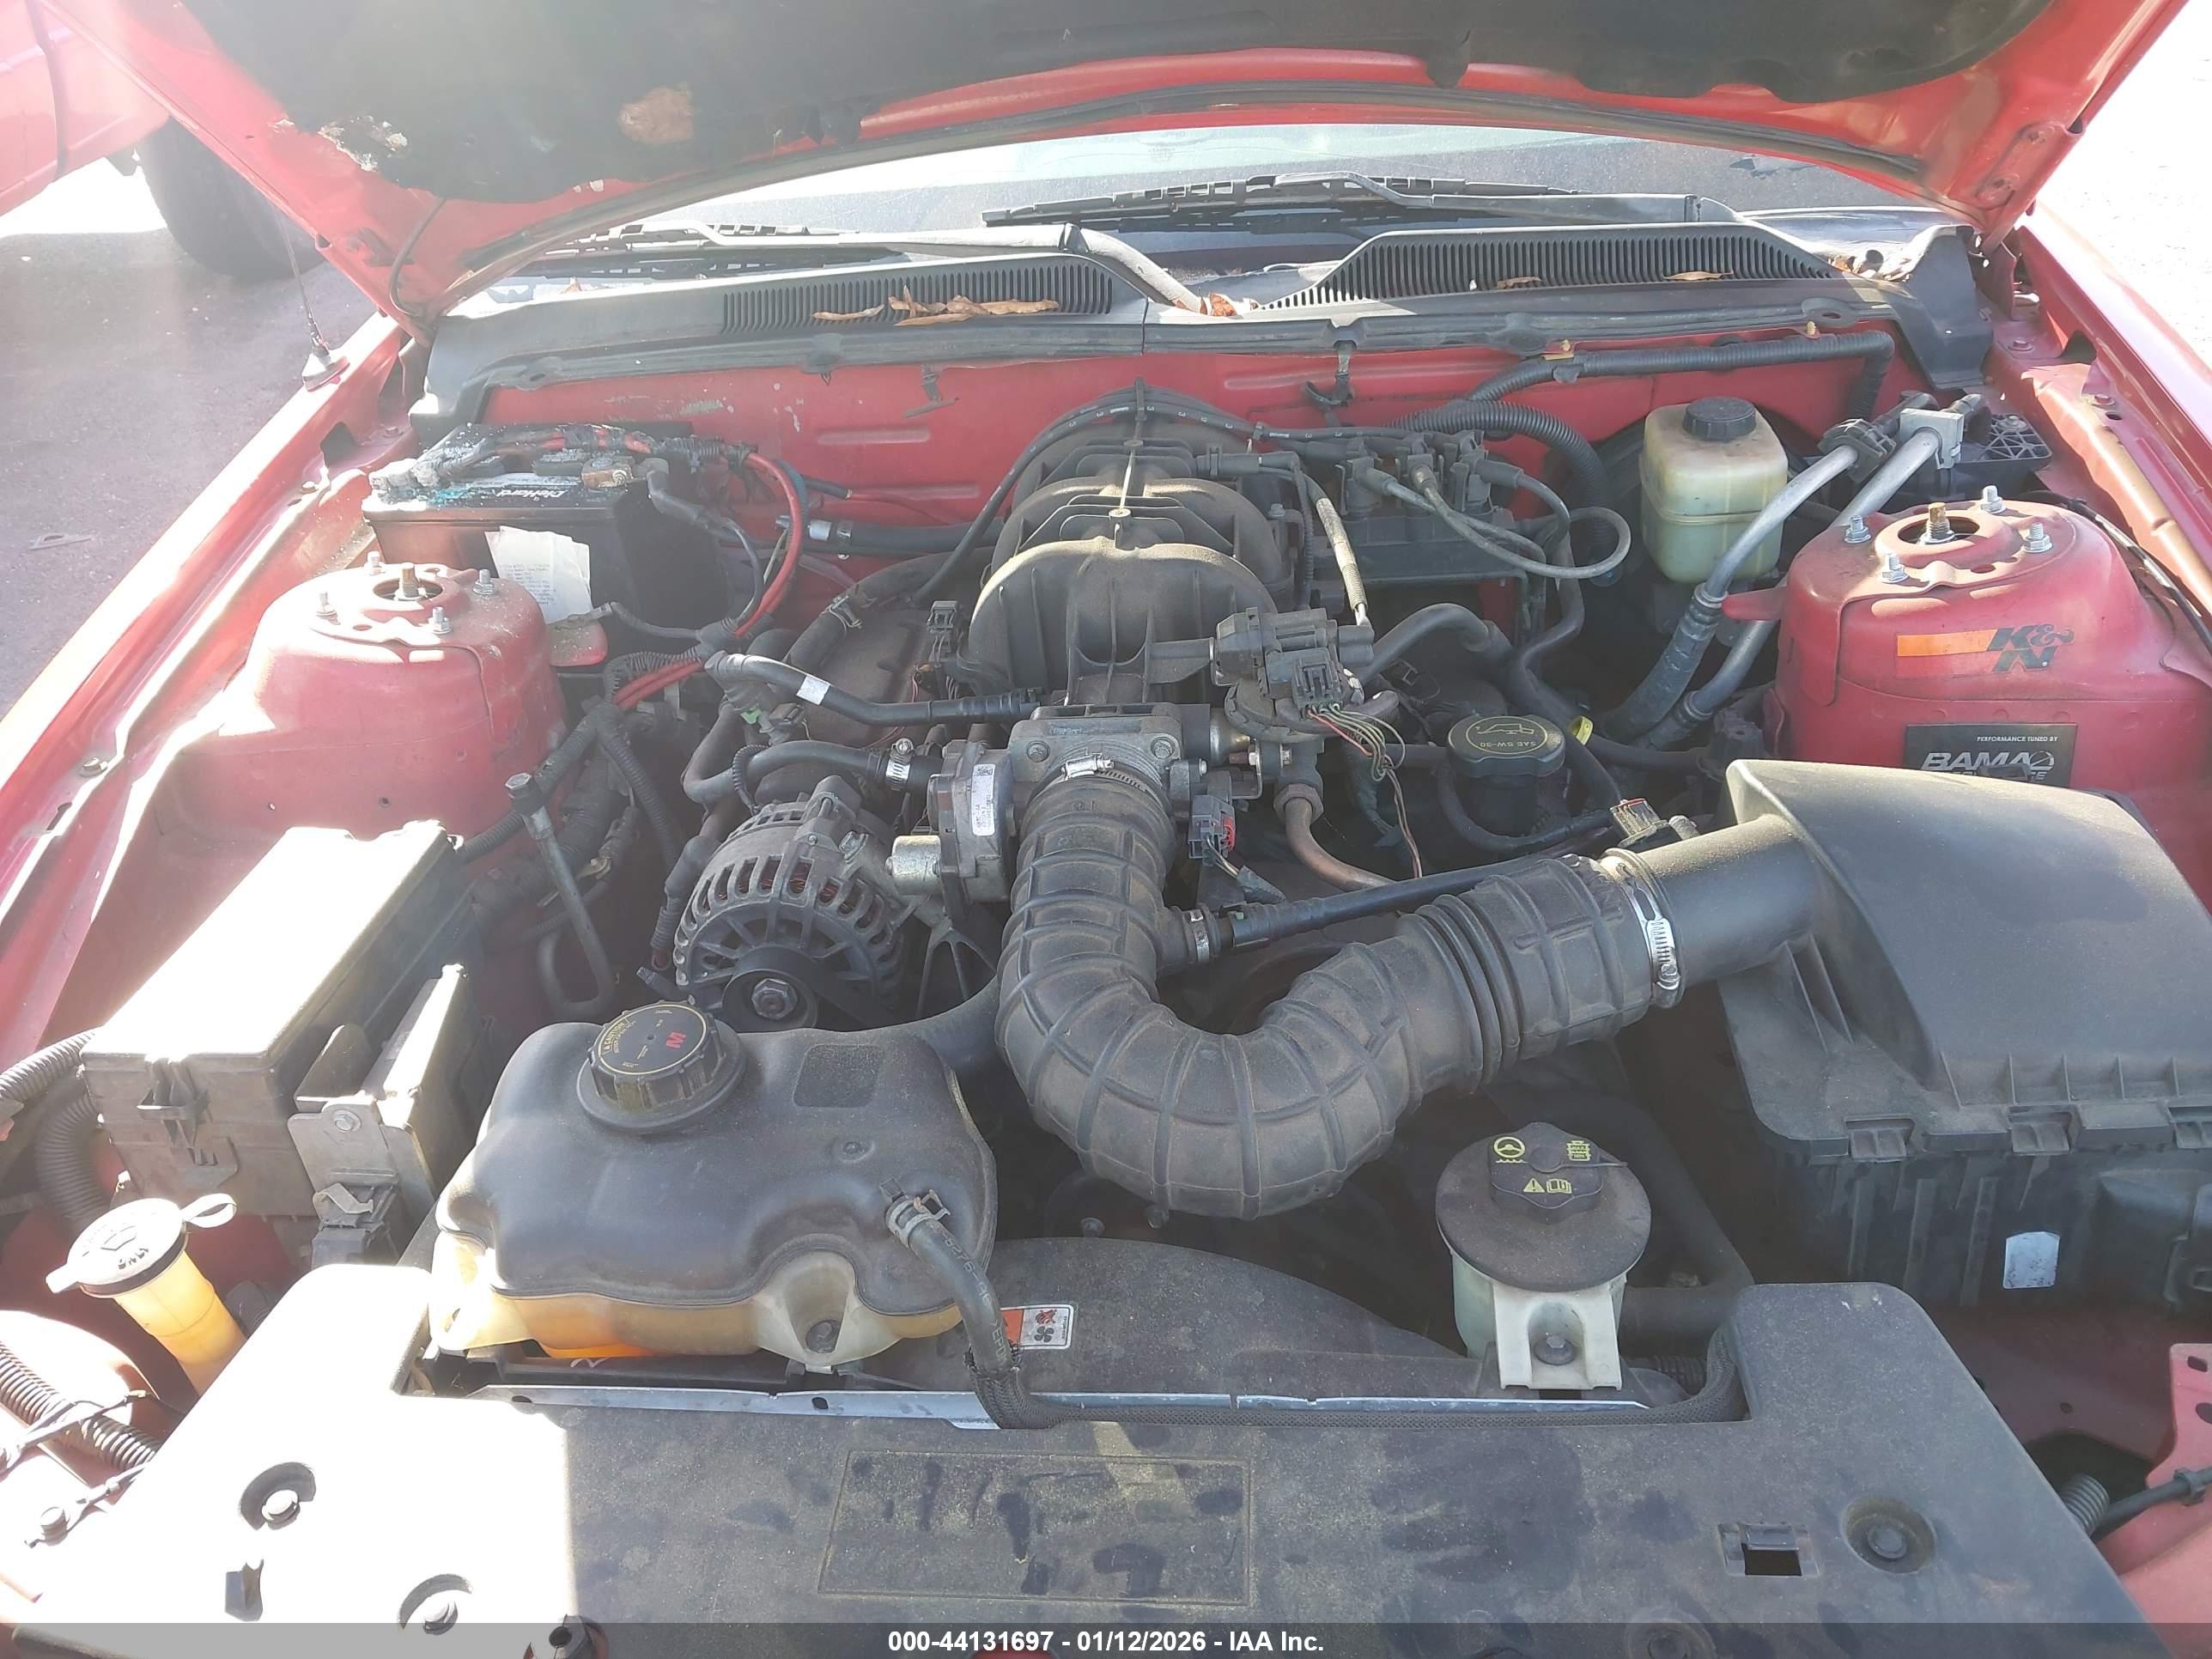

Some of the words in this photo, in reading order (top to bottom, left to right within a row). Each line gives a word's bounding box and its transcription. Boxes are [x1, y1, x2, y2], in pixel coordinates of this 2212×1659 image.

[495, 489, 568, 498] DieHard
[1986, 623, 2075, 673] K&N
[1921, 751, 2031, 771] BAMA
[604, 1022, 624, 1045] CAUTION
